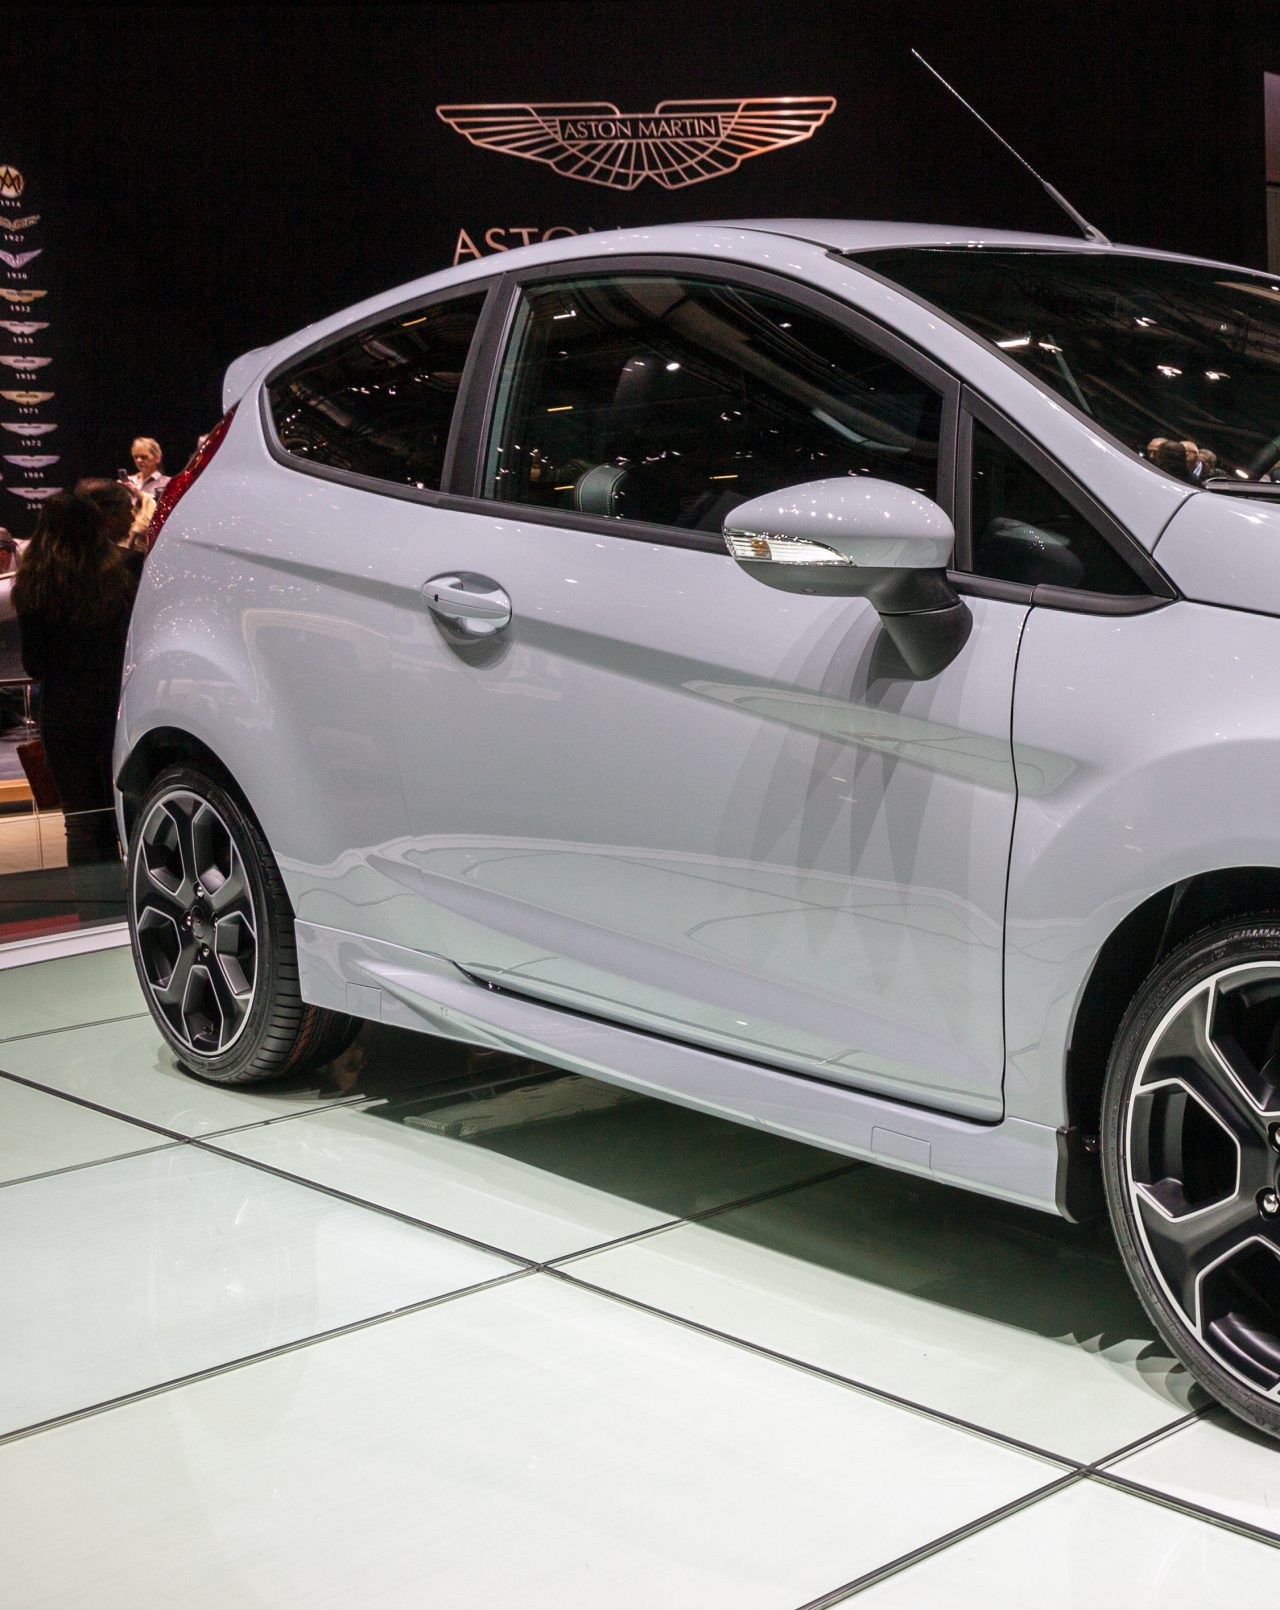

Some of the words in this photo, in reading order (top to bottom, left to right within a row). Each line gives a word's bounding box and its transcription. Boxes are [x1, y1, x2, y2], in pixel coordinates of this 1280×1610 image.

[564, 121, 632, 139] ASTON
[638, 119, 716, 137] MARTIN
[453, 226, 622, 267] AST
